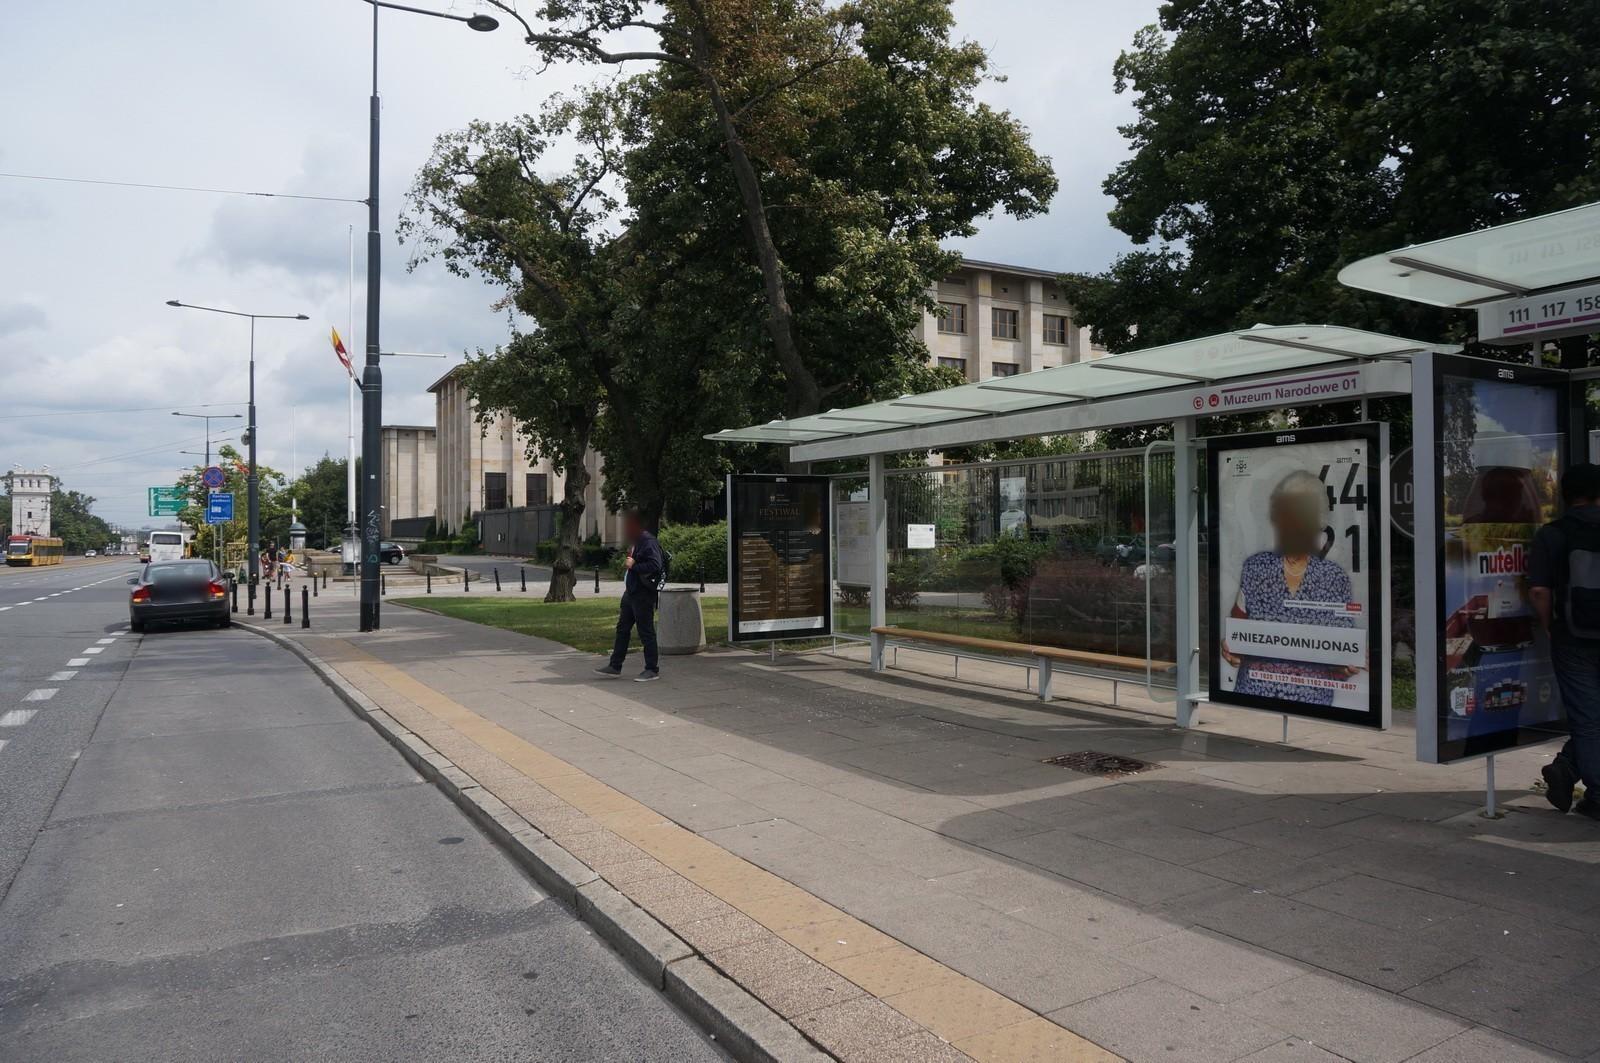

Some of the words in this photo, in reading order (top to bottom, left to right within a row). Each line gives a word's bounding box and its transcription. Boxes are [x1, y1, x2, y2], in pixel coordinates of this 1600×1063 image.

[1509, 307, 1530, 323] 111
[1542, 301, 1566, 318] 117
[1497, 367, 1514, 379] ams
[1223, 392, 1272, 406] Muzeum
[1275, 383, 1339, 398] Narodowe
[1342, 378, 1357, 390] 01
[1276, 433, 1296, 444] ams
[1231, 631, 1360, 653] #NIEZAPOMNIJONAS
